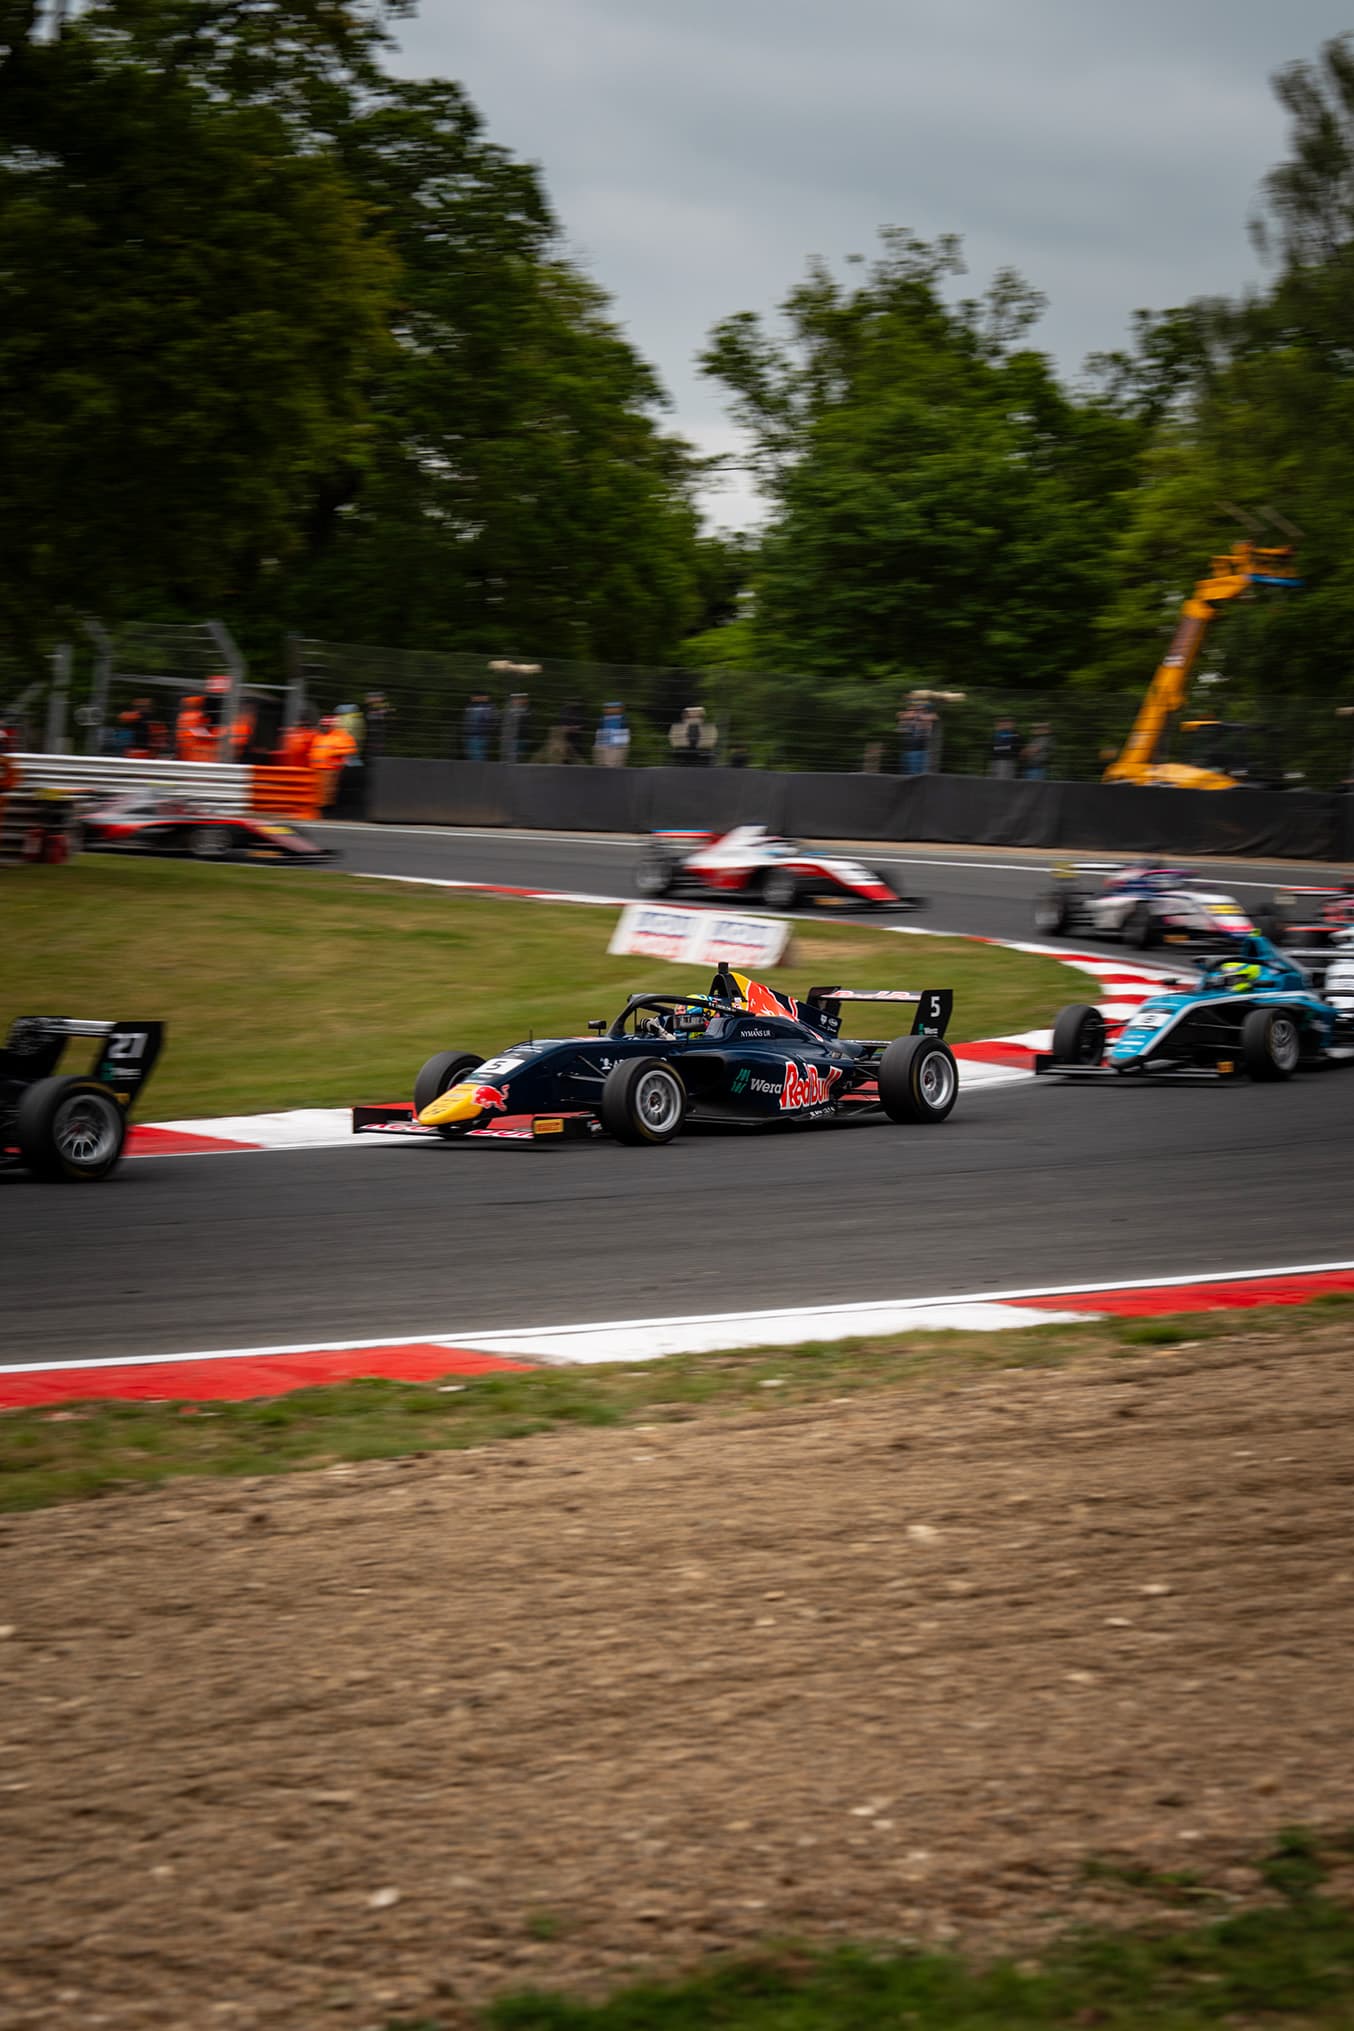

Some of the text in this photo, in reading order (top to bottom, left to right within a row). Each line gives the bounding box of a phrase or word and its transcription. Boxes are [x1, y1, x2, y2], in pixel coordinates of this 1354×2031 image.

[930, 996, 940, 1018] 5
[486, 1060, 506, 1071] 5
[750, 1078, 782, 1095] Wera
